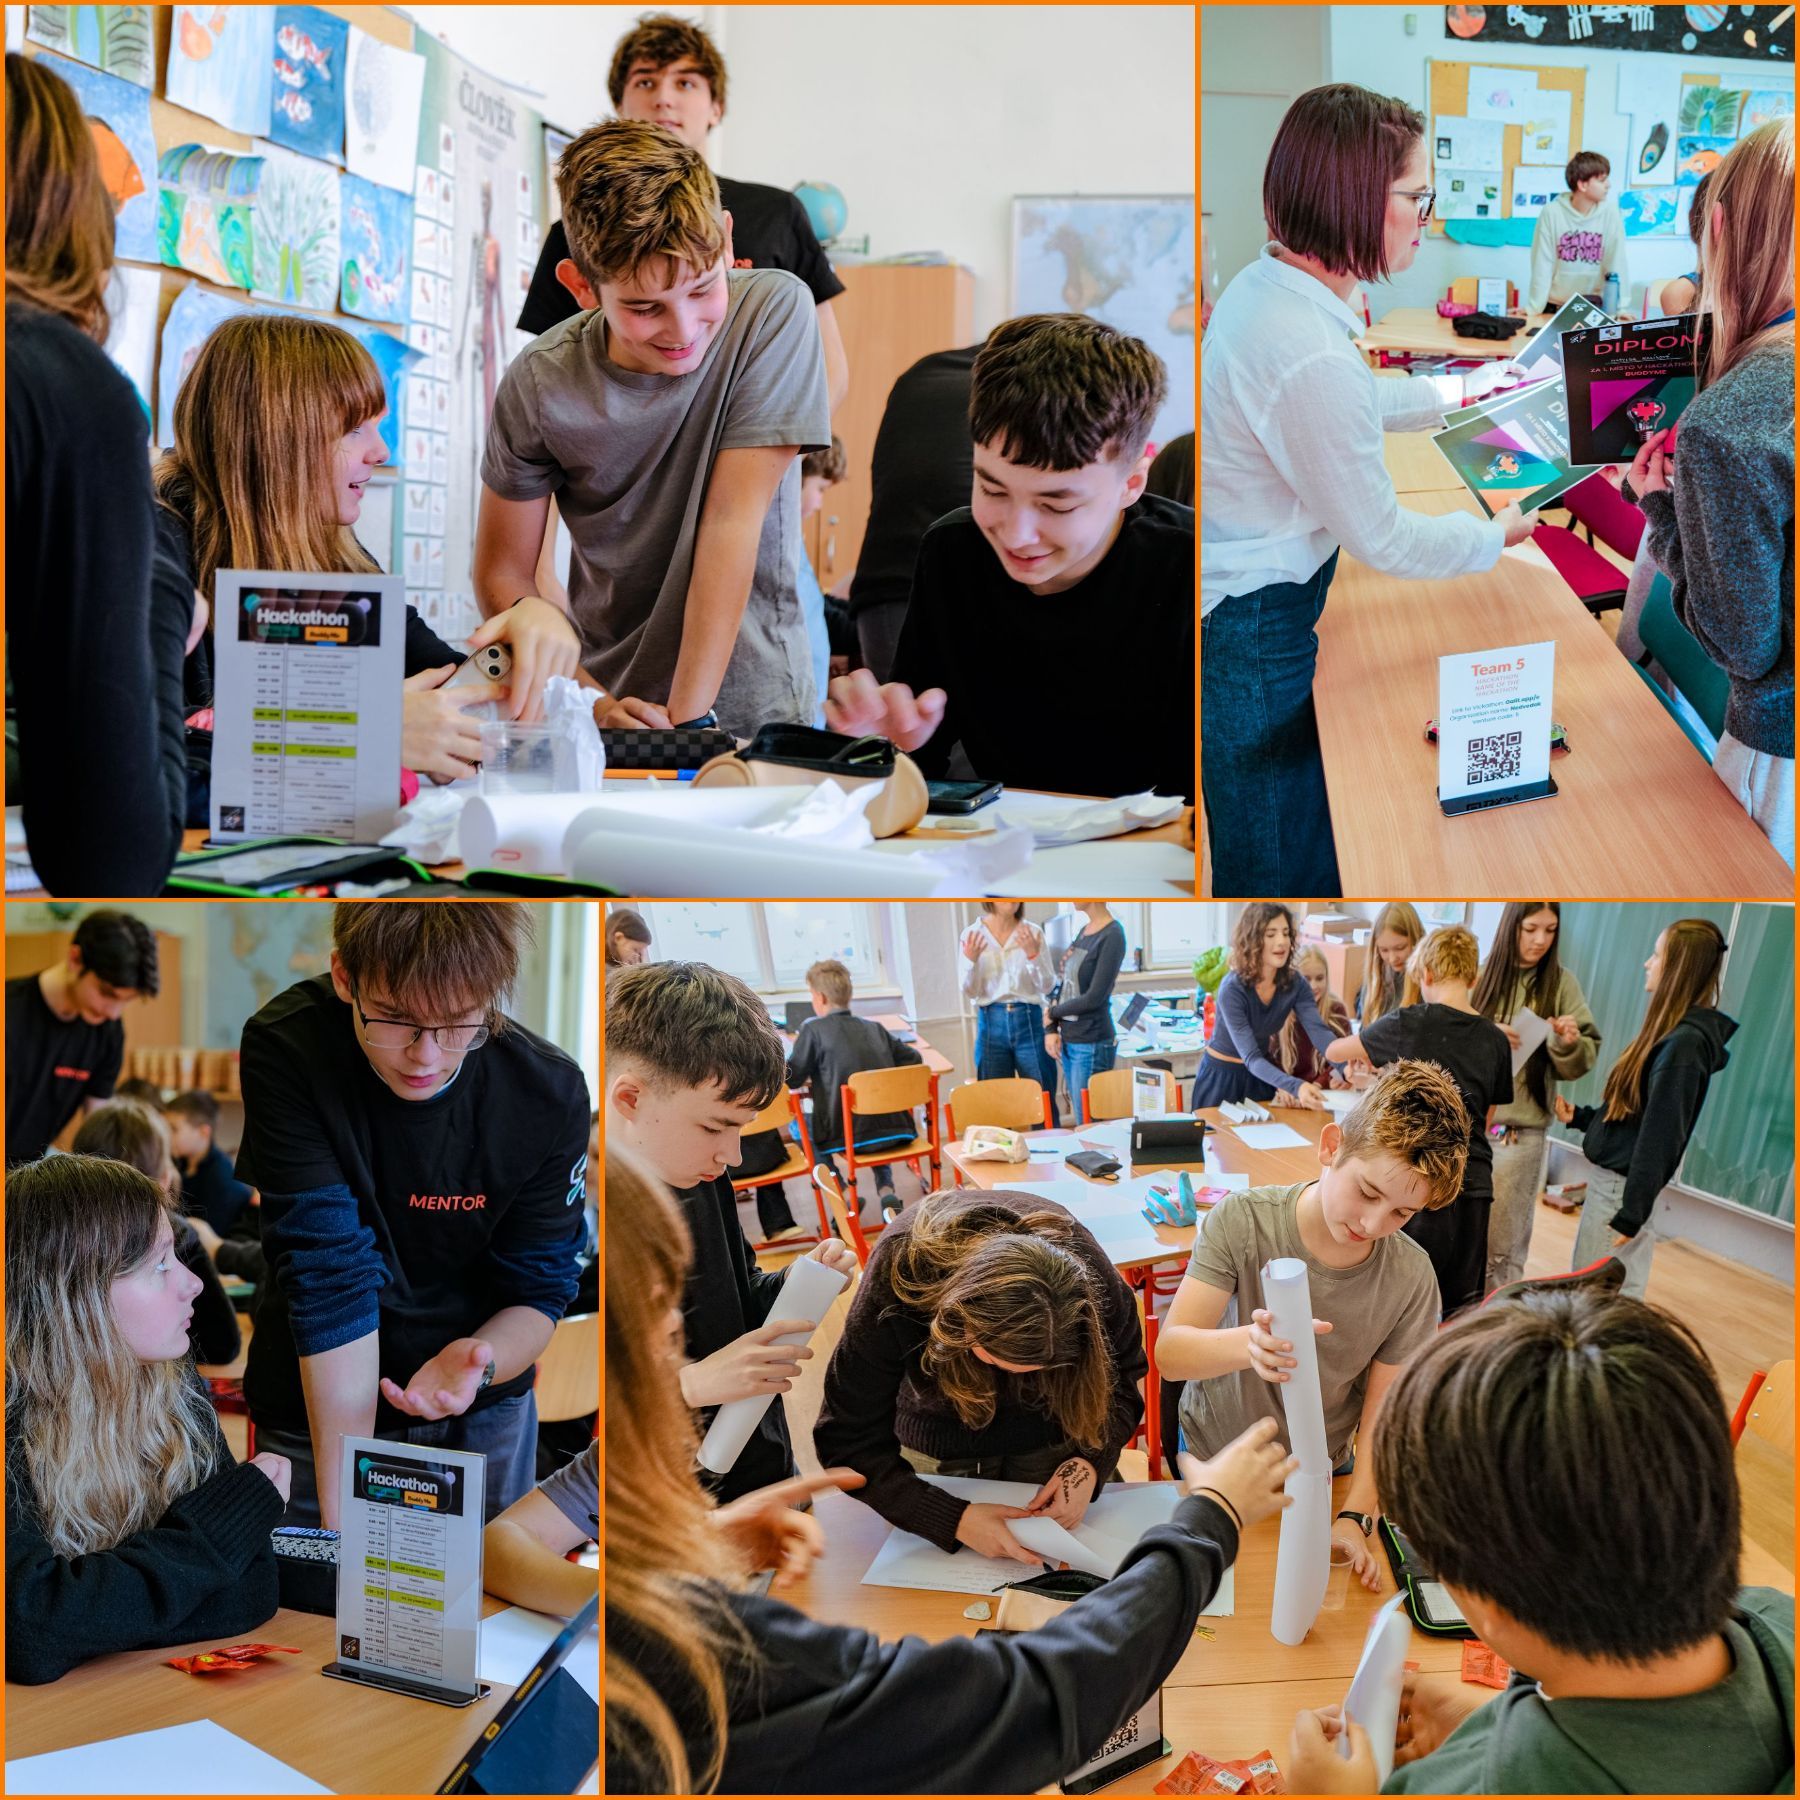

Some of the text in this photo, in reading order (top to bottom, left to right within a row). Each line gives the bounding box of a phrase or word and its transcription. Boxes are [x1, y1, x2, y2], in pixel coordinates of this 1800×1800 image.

[459, 71, 517, 140] ČLOVĚK
[1594, 333, 1705, 356] DIPLOM
[1625, 369, 1668, 377] BUDDYME
[256, 608, 349, 626] Hackathon
[1471, 657, 1525, 677] Team 5
[1476, 673, 1519, 684] HACKATHON
[1475, 683, 1494, 692] NAME
[1476, 686, 1519, 697] HACKATHON
[409, 1194, 487, 1211] MENTOR
[368, 1470, 438, 1494] Hackathon
